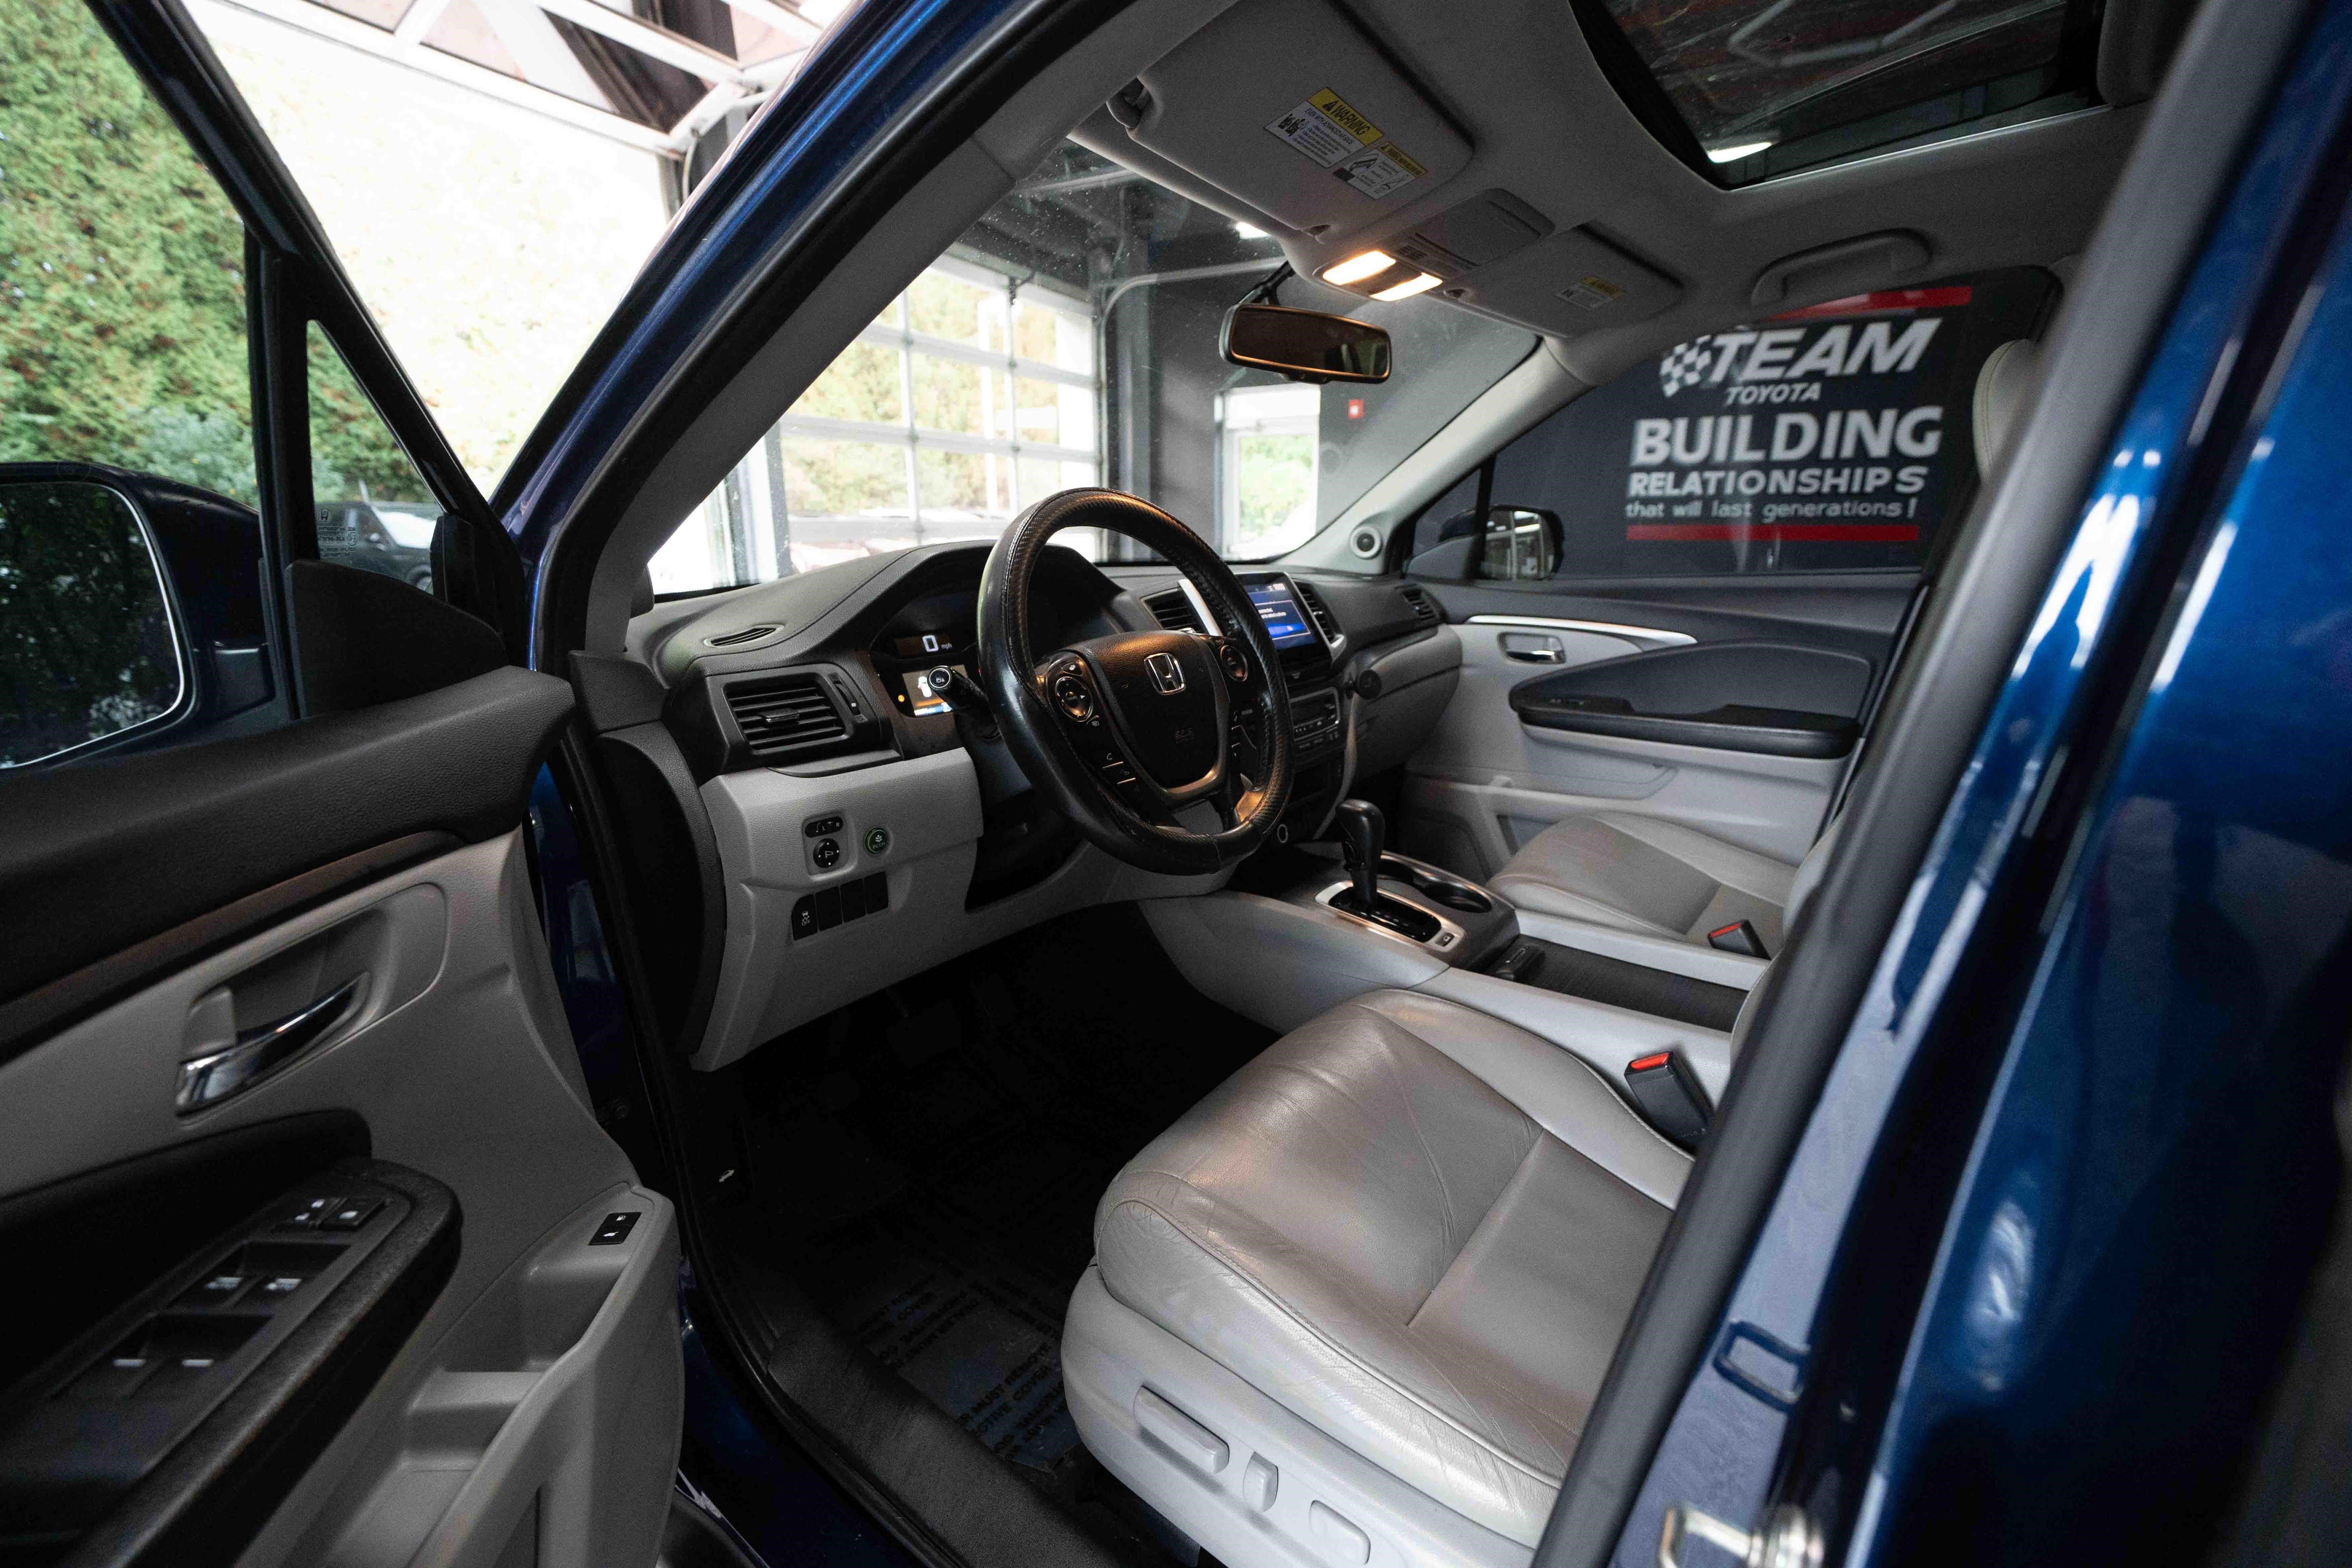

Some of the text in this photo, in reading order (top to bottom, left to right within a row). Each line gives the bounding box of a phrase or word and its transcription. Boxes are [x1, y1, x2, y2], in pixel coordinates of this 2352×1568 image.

[1313, 114, 1326, 123] WITH
[1329, 104, 1372, 136] WARNING
[1711, 318, 1943, 383] TEAM
[1724, 382, 1822, 406] TOYOTA
[1632, 407, 1943, 466] BUILDING
[1628, 466, 1929, 497] RELATIONSHIPS
[1626, 502, 1664, 519] that
[1673, 500, 1702, 518] will
[1711, 500, 1751, 518] last
[922, 635, 939, 652] 0
[971, 1384, 1004, 1414] MUST
